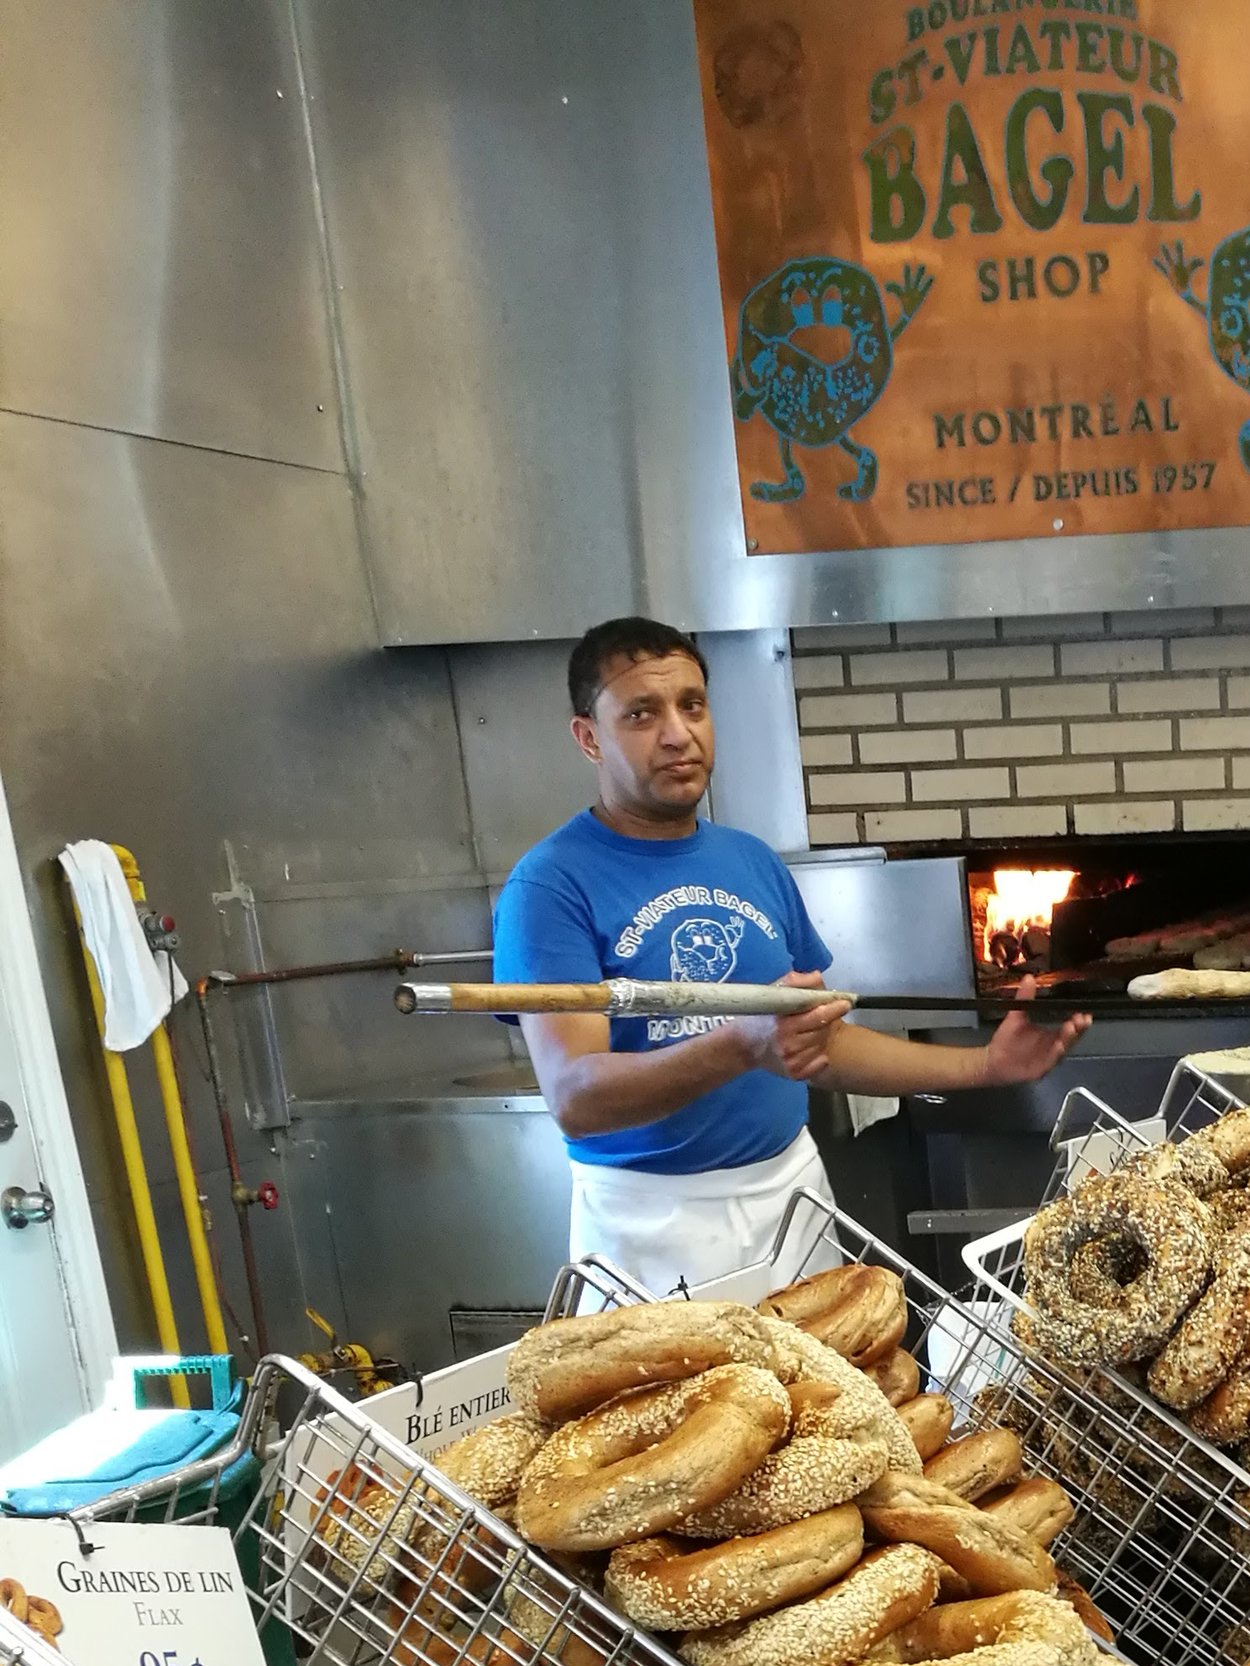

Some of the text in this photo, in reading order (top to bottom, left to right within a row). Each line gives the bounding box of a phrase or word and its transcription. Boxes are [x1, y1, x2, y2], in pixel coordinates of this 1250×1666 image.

[861, 86, 1201, 243] BAGEL
[978, 250, 1110, 303] SHOP
[932, 395, 1180, 449] MONTRÉAL
[905, 476, 997, 510] SINCE
[1033, 465, 1139, 501] DEPUIS
[1152, 460, 1217, 494] 1957
[614, 885, 713, 958] ST-VIATEUR
[405, 1386, 511, 1445] BLÉ ENTIER
[57, 1560, 234, 1593] GRAINES DE LIN
[133, 1601, 184, 1626] FLAX
